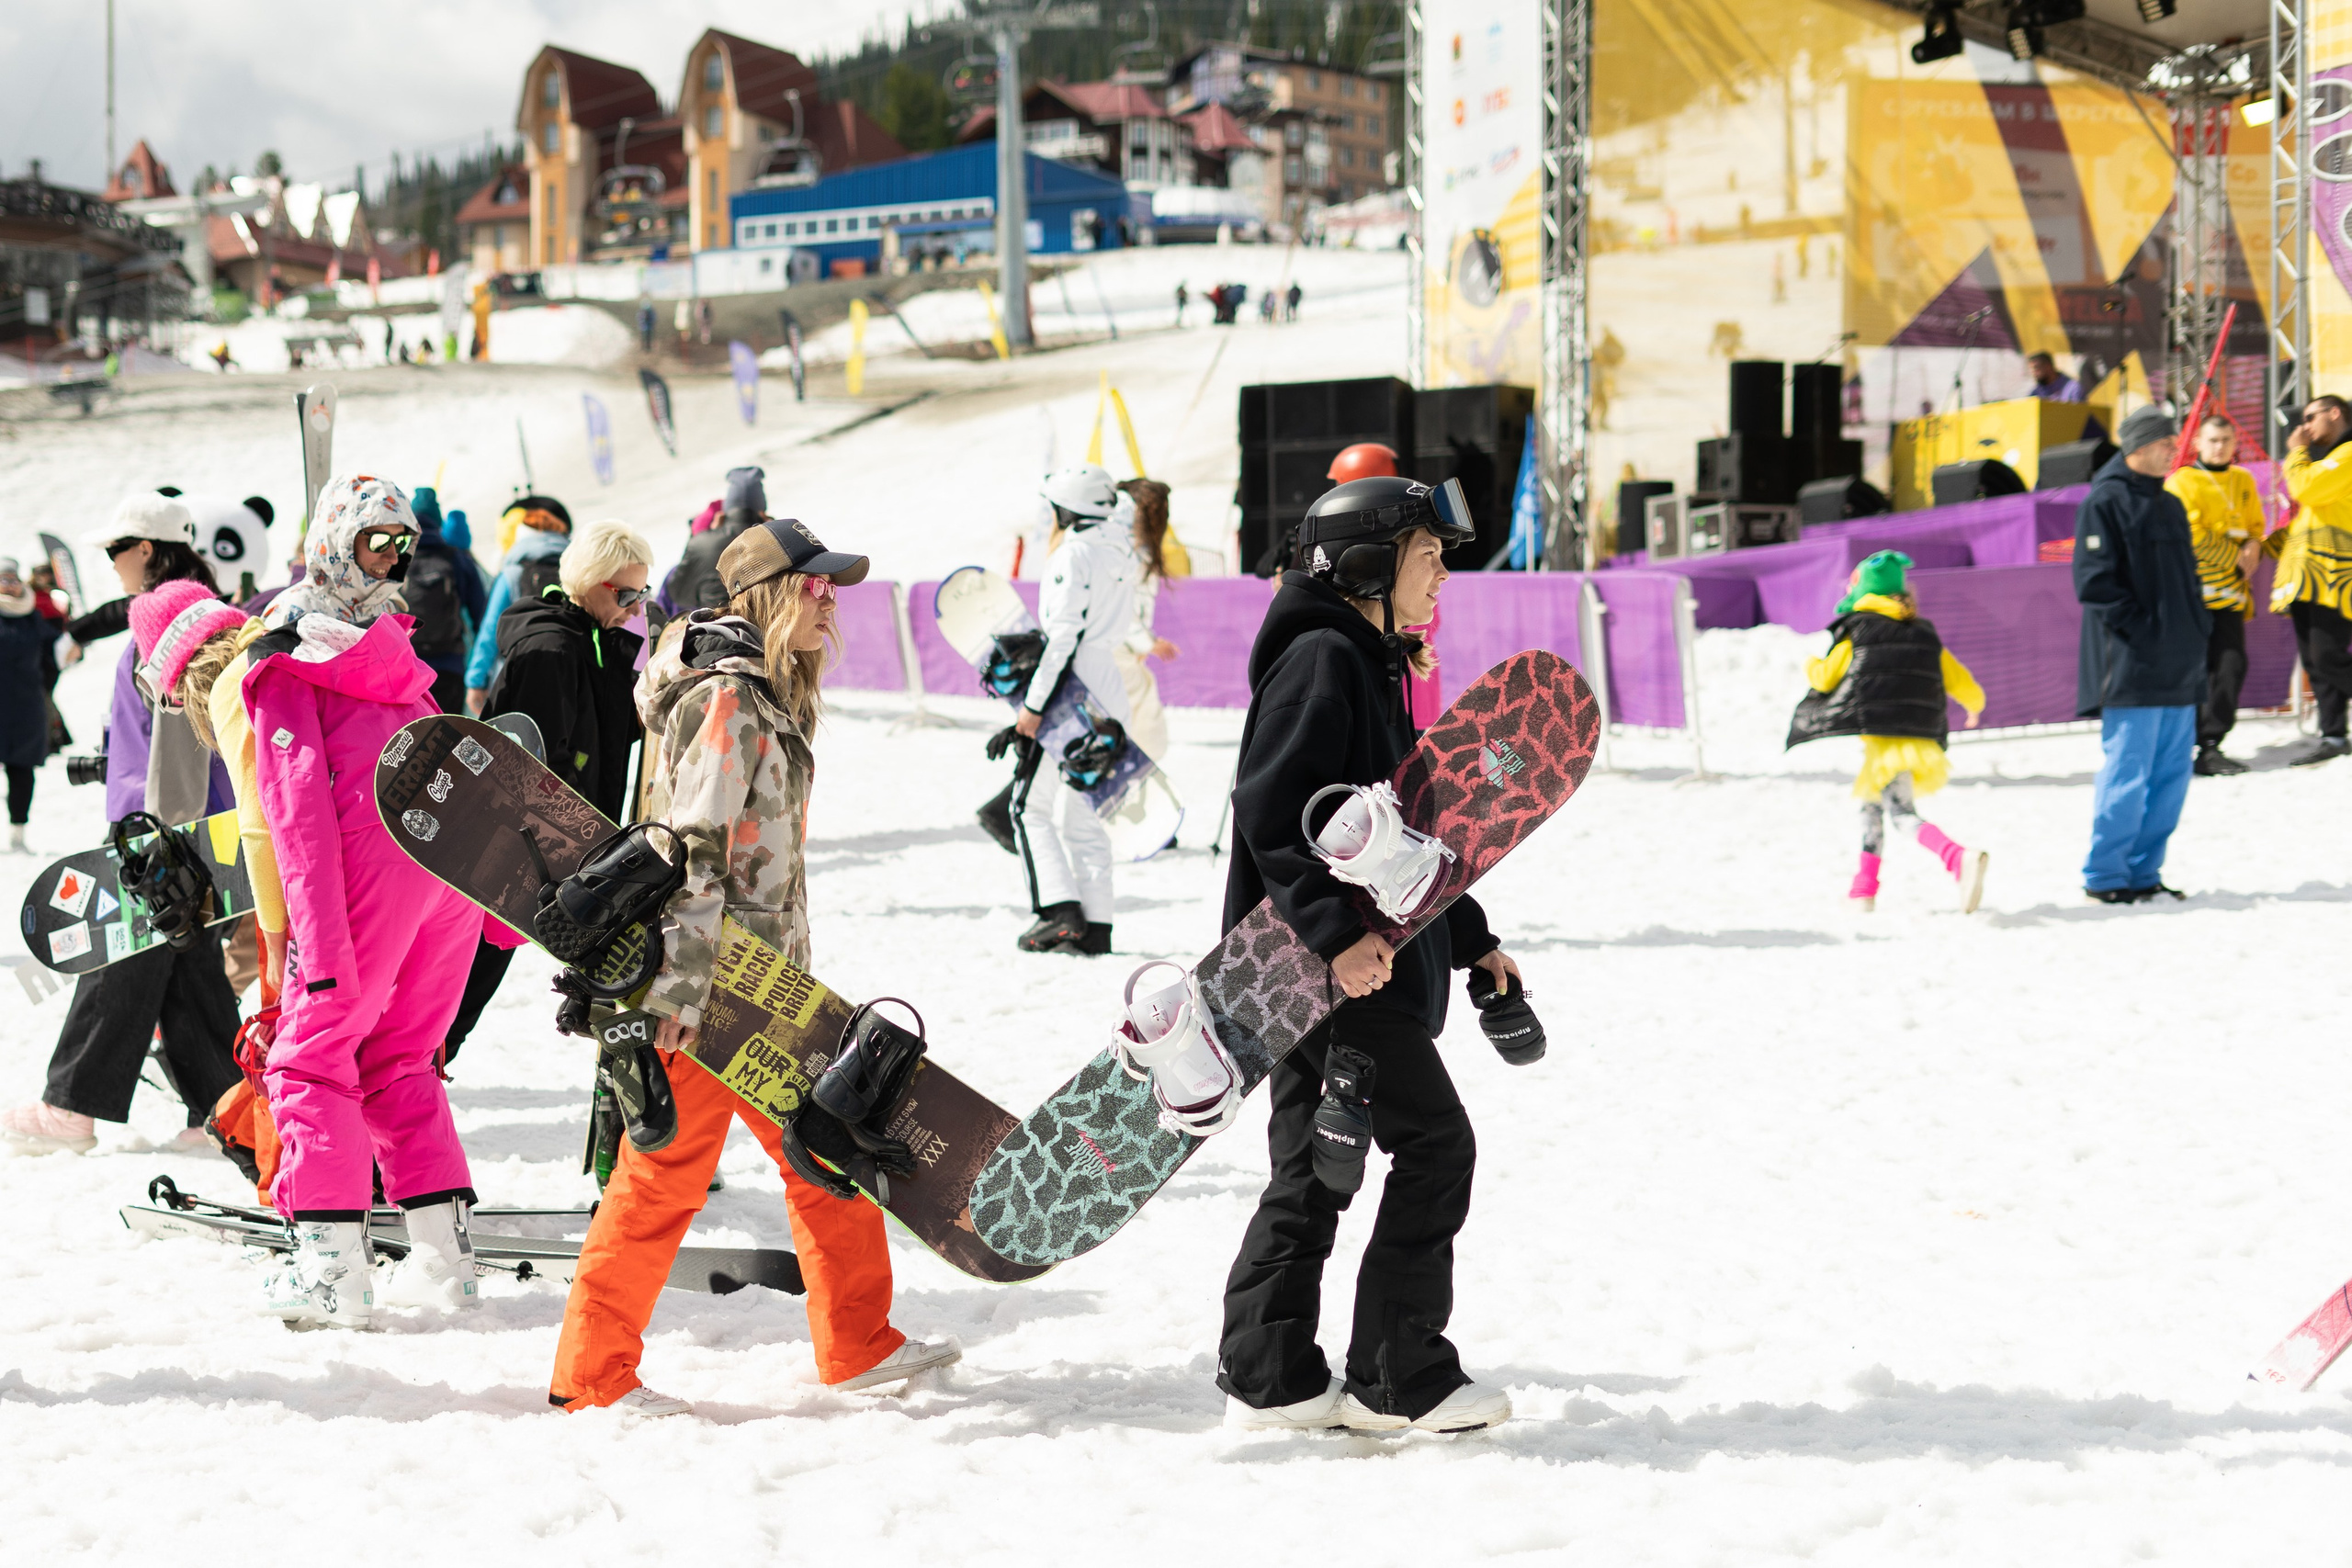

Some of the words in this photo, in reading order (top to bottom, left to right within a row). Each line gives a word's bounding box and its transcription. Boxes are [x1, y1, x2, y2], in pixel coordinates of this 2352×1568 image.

[703, 1016, 735, 1033] LICE
[745, 1036, 793, 1079] OUR
[808, 1054, 827, 1076] COURSE
[734, 1060, 773, 1094] MY
[919, 1134, 950, 1168] XXX
